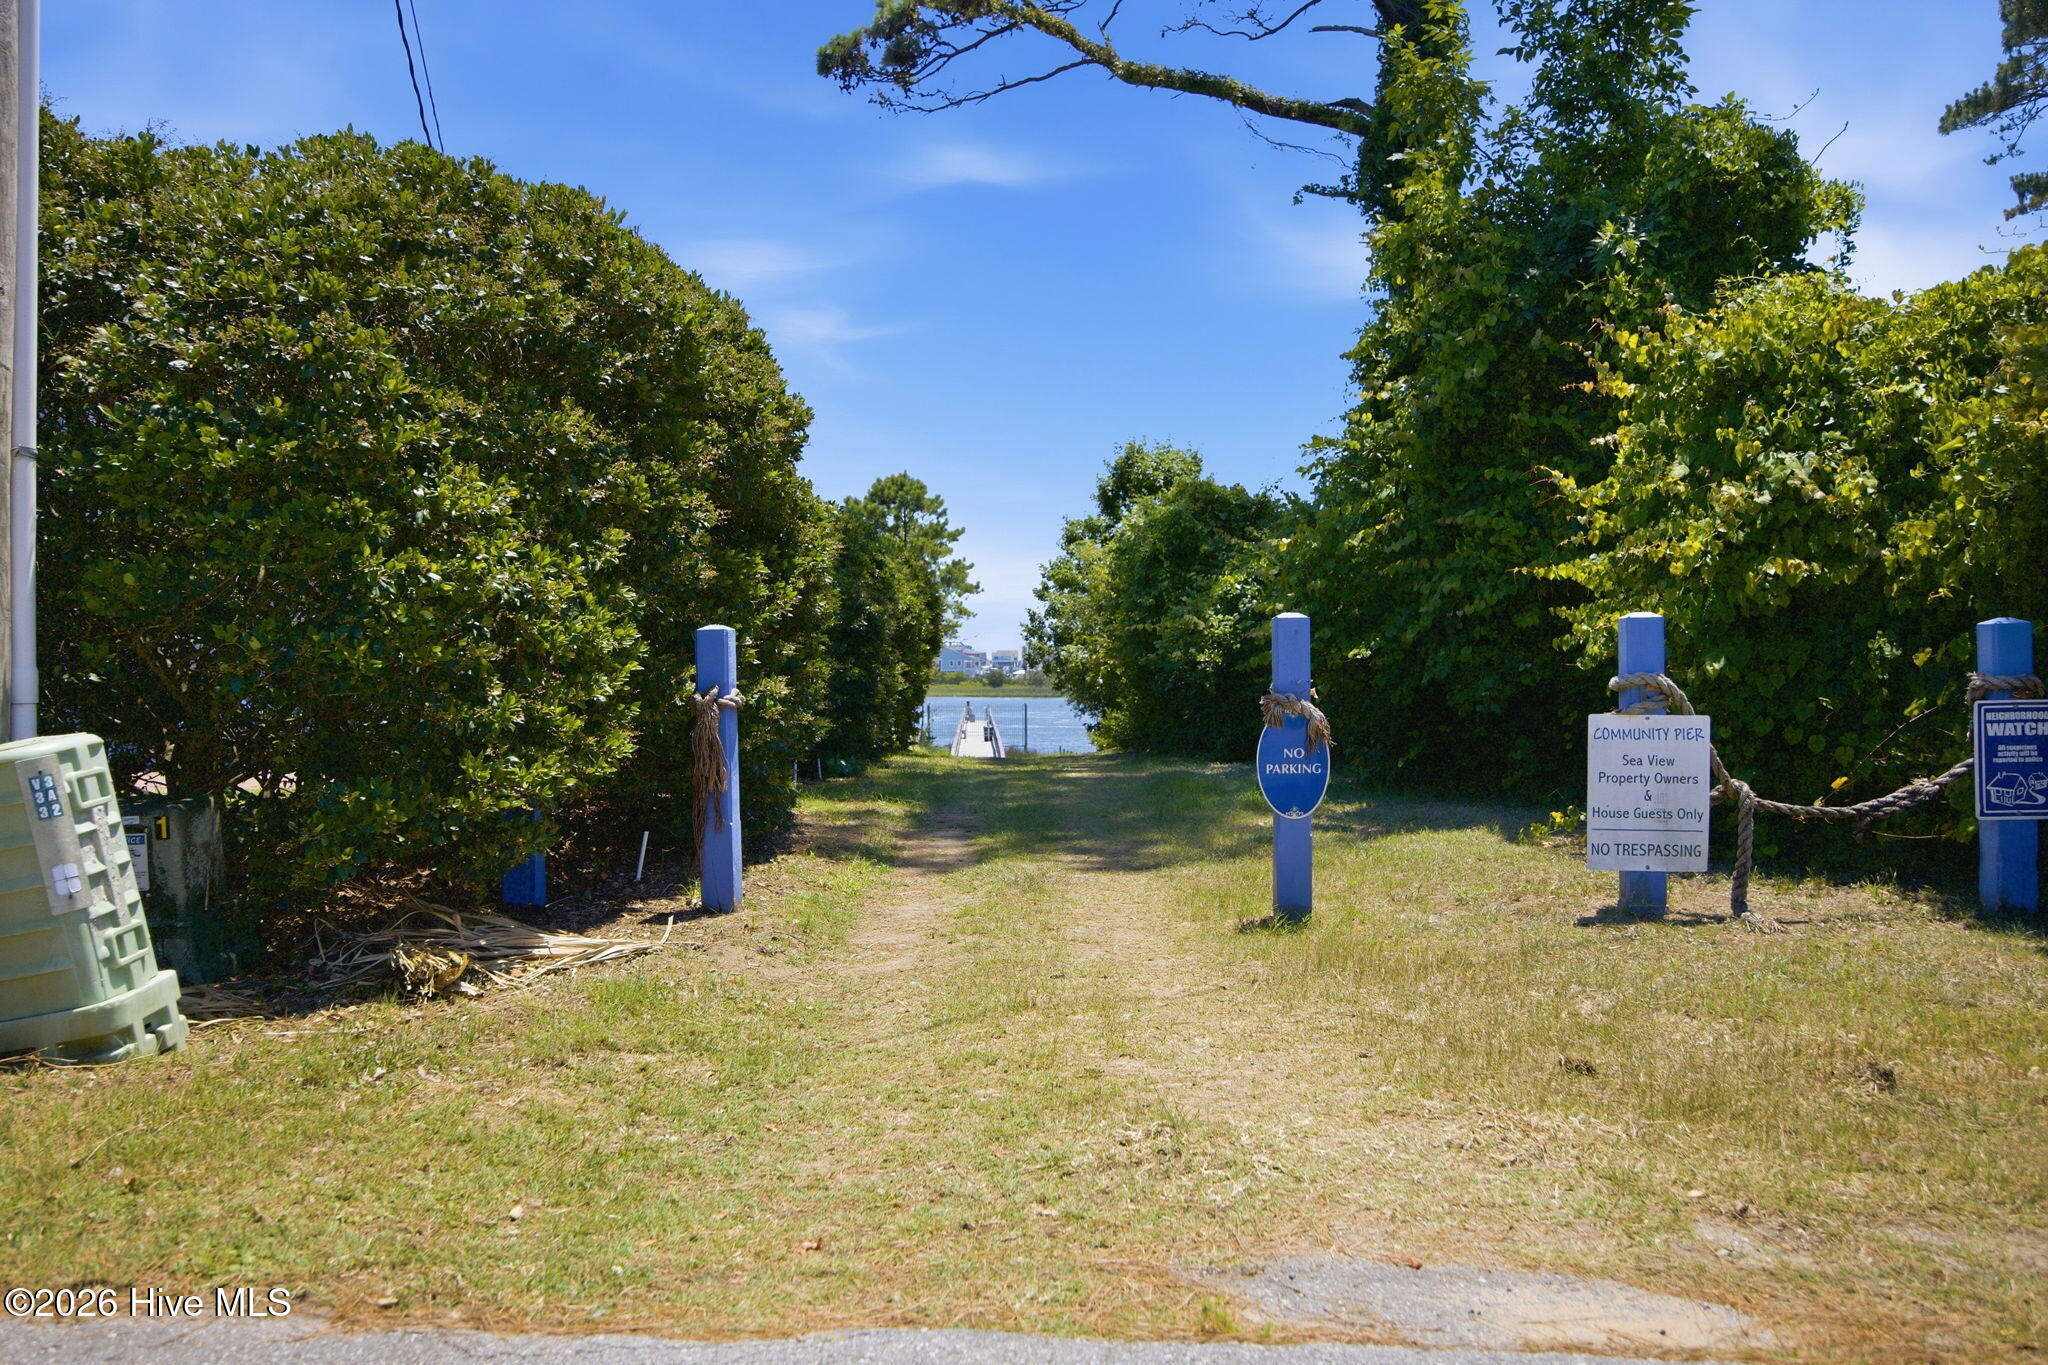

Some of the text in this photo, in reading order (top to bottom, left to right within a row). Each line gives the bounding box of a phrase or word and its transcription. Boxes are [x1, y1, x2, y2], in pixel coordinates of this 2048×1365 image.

[1593, 727, 1705, 742] COMMUNITY PIER
[1986, 721, 2048, 736] WATCH
[1283, 747, 1305, 759] NO
[1622, 754, 1675, 767] Sea View
[1266, 763, 1322, 774] PARKING
[1598, 771, 1699, 786] Property Owners
[1644, 790, 1652, 801] &
[1592, 806, 1704, 823] House Guests Only
[156, 816, 167, 839] 1
[1591, 843, 1702, 857] NO TRESPASSING
